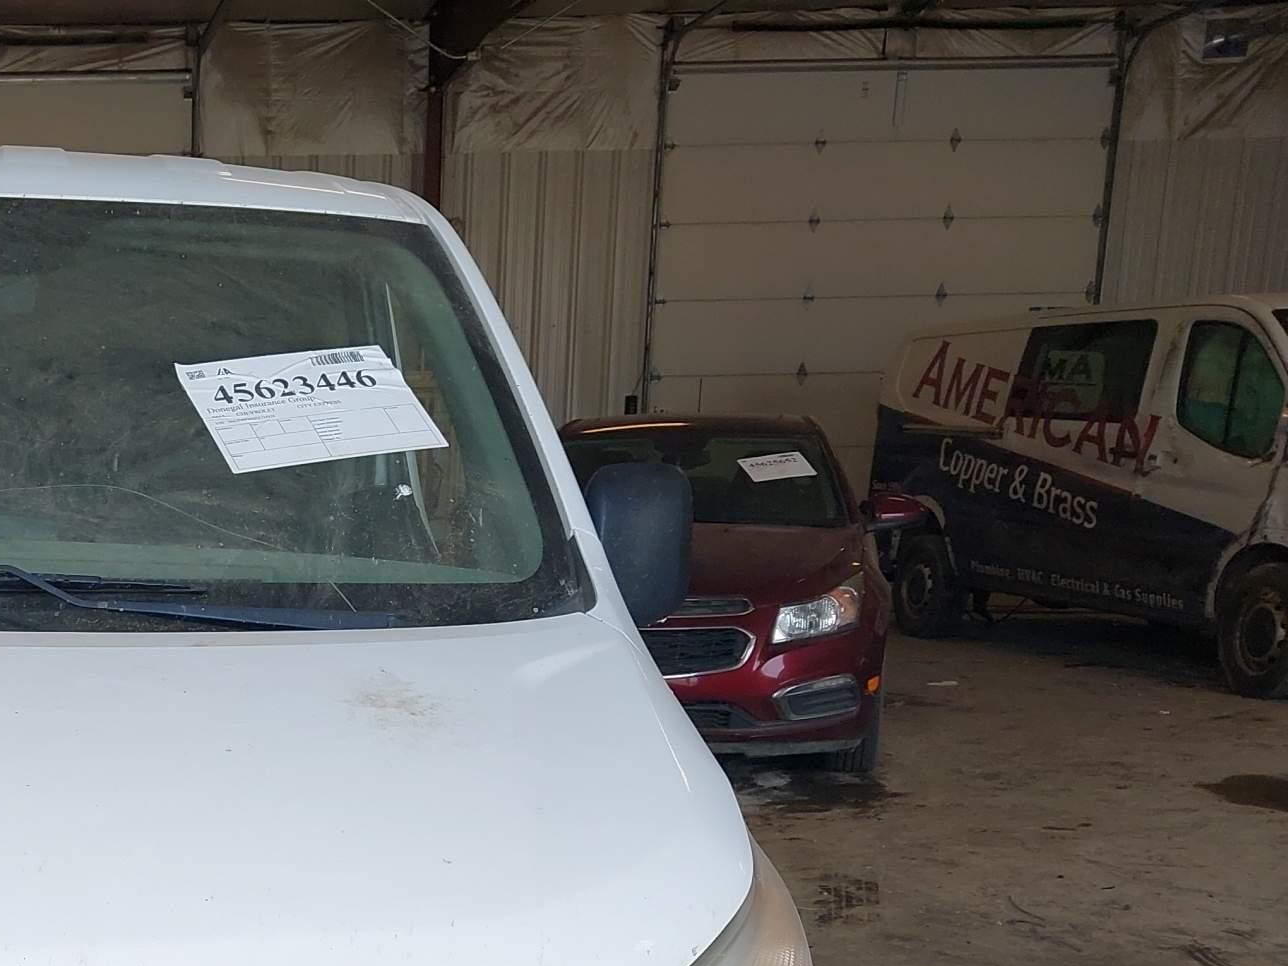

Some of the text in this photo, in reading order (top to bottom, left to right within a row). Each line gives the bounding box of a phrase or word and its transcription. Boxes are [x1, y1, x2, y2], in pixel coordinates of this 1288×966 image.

[214, 369, 377, 404] 45623446
[939, 437, 1098, 528] Copper & Brass
